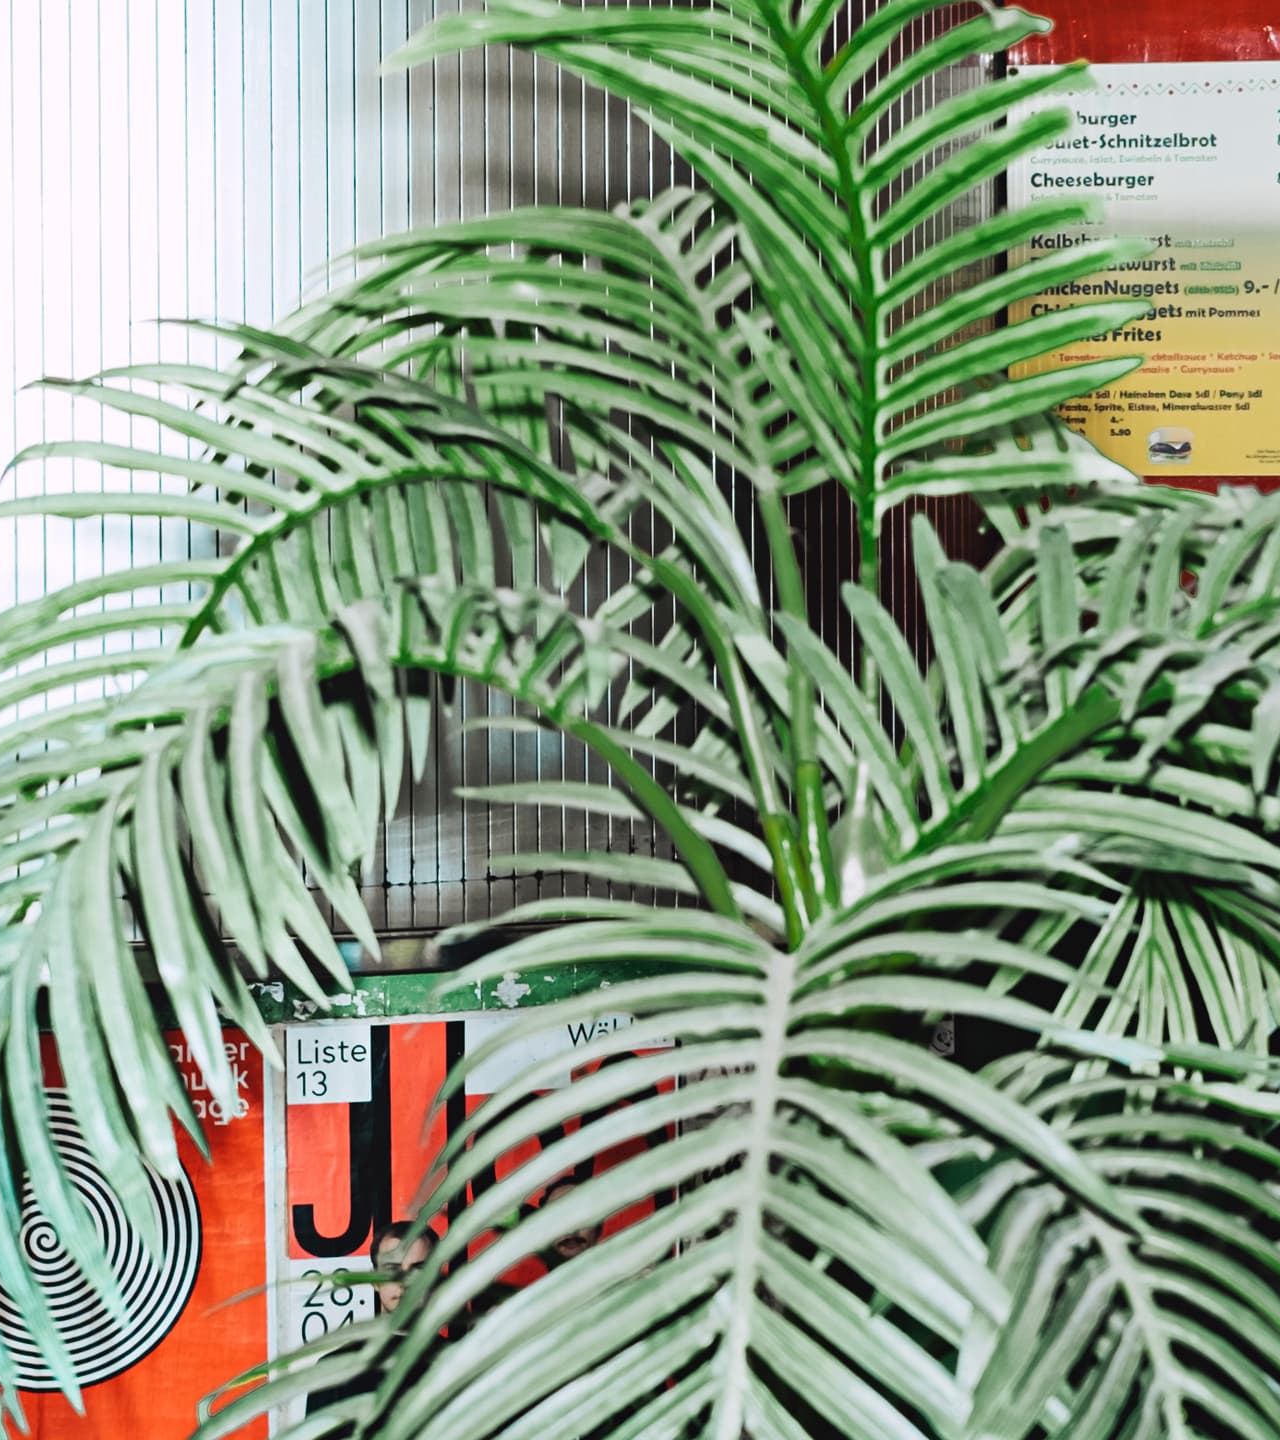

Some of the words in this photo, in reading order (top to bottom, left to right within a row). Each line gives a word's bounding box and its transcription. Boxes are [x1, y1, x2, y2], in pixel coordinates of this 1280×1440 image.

[1031, 111, 1137, 128] burger
[1030, 172, 1154, 188] Cheeseburger
[1186, 308, 1206, 318] mit
[1209, 307, 1260, 318] Pommes
[1112, 328, 1162, 342] Frites
[297, 1038, 367, 1065] Liste
[297, 1071, 328, 1097] 13
